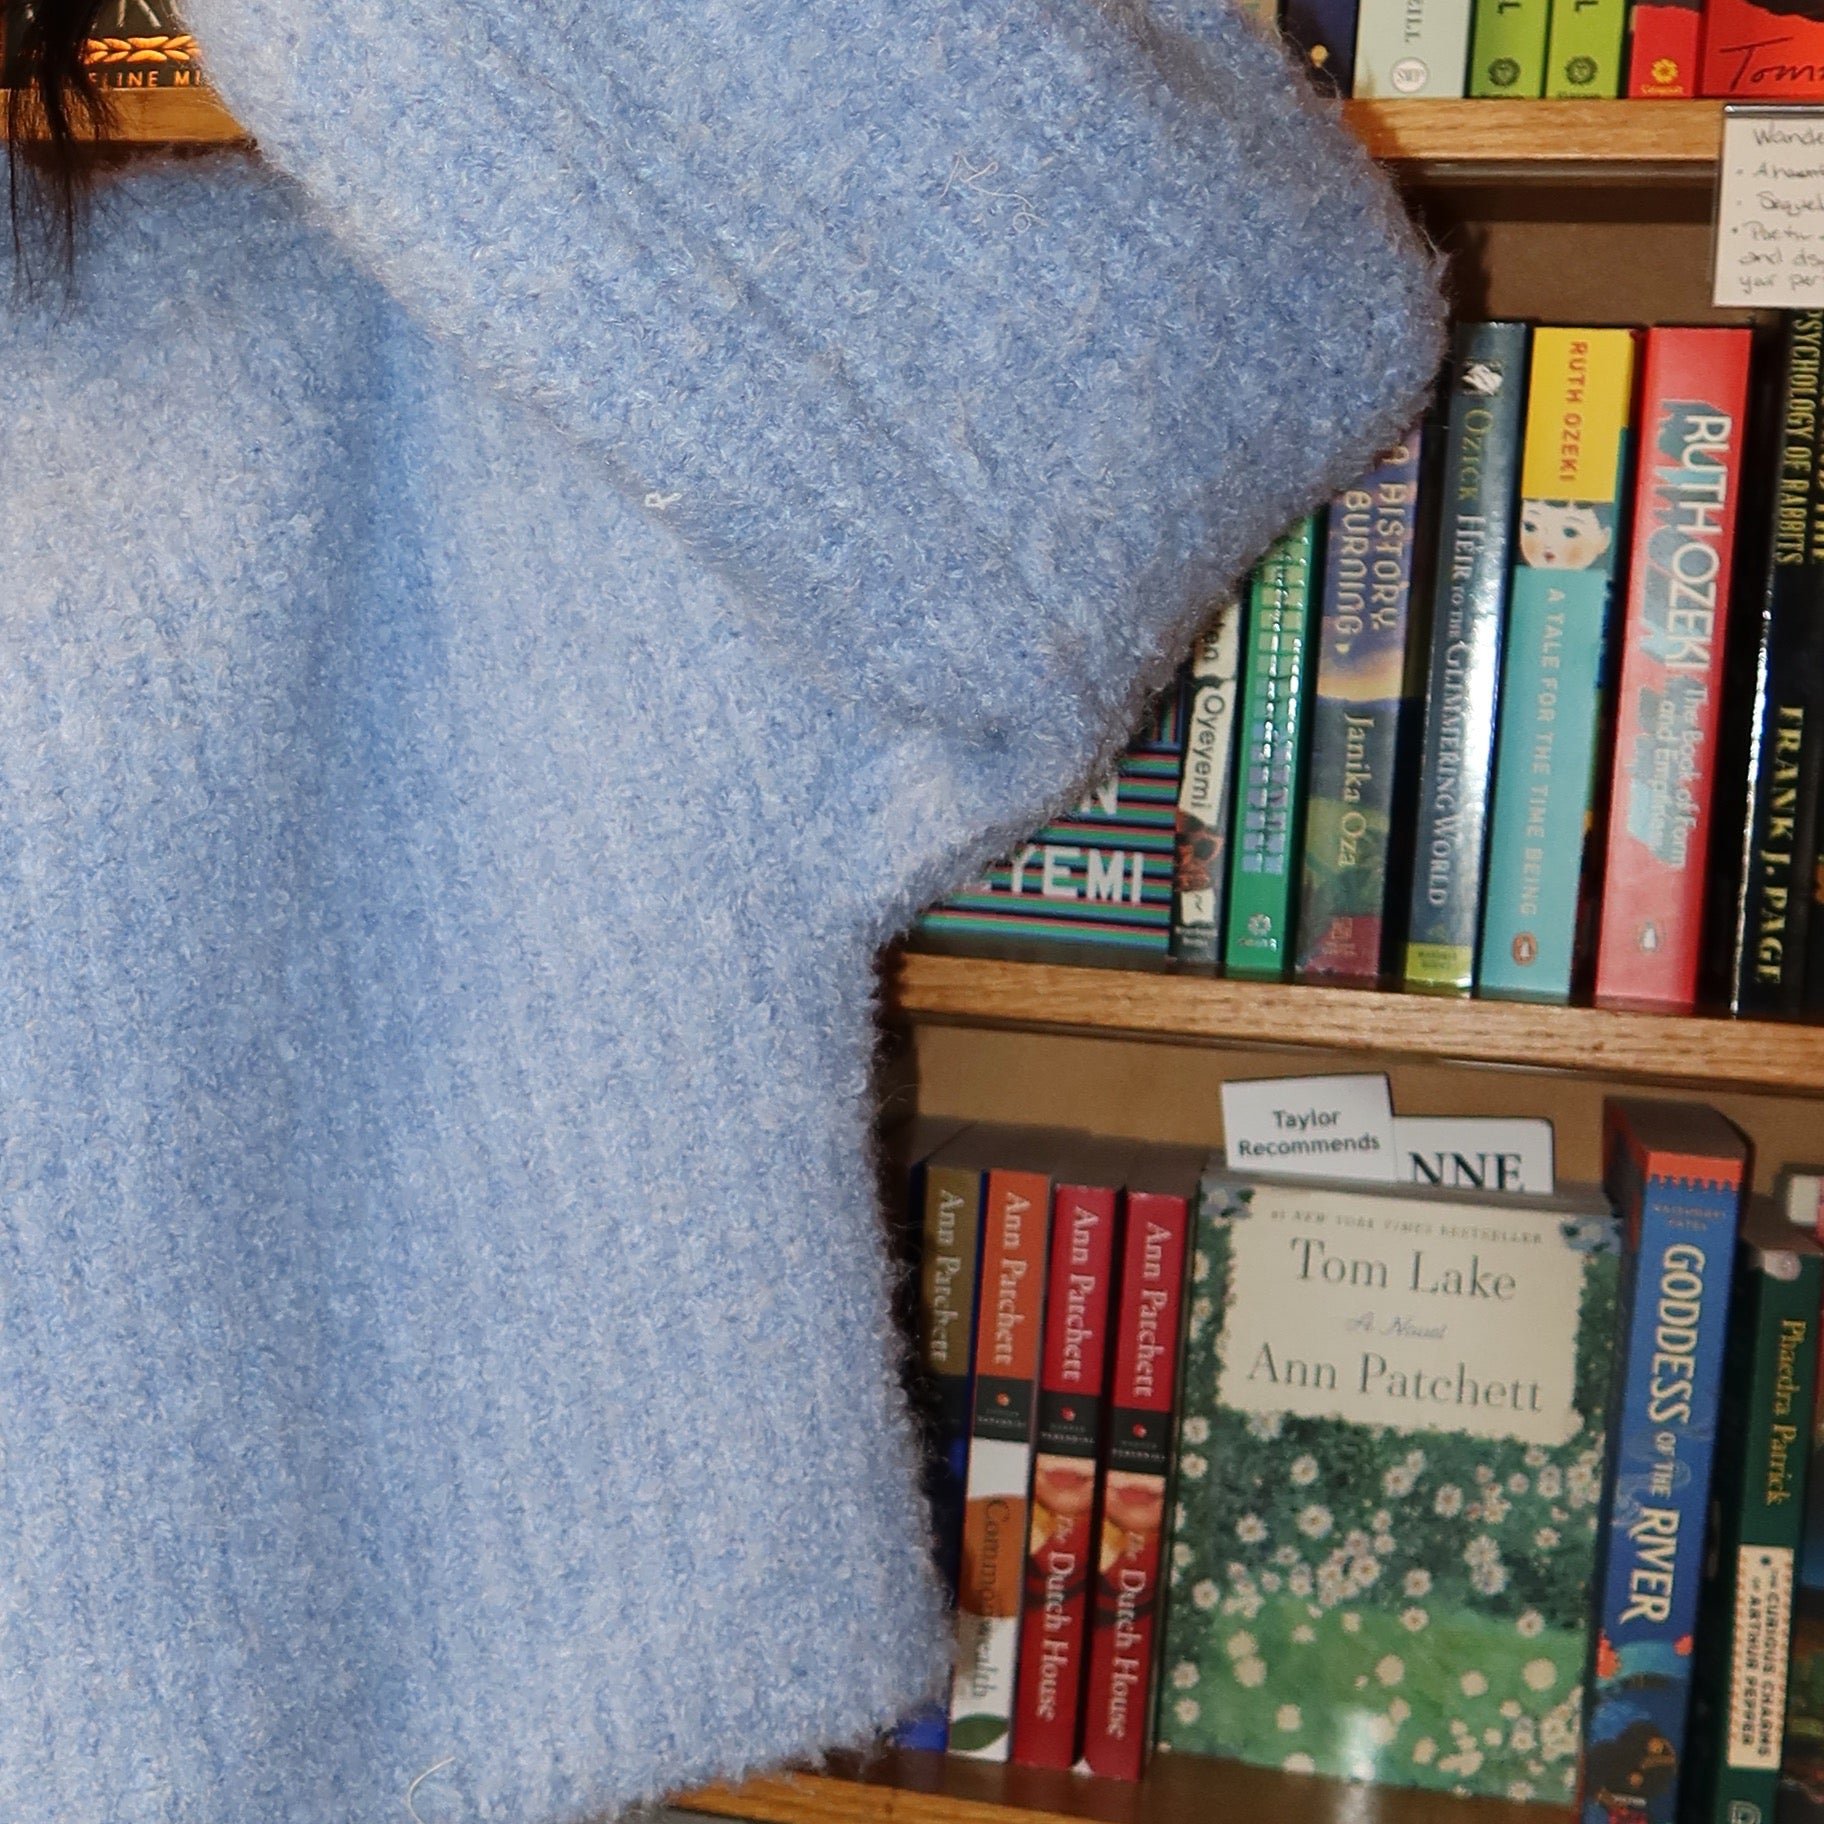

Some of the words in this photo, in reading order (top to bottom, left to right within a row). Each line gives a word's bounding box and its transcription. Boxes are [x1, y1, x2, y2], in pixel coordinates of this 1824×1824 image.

[1570, 340, 1590, 408] RUTH
[1560, 413, 1582, 482] OZEKI
[1676, 414, 1732, 535] RUTH
[1548, 588, 1565, 603] A
[1665, 542, 1720, 670] OZEKI
[1541, 613, 1565, 669] TALE
[1538, 677, 1558, 723] FOR
[1190, 693, 1225, 809] Oyeyemi
[1343, 713, 1374, 804] Janika
[1533, 732, 1553, 774] THE
[1337, 811, 1368, 868] Oza
[1528, 784, 1549, 838] TIME
[1521, 848, 1541, 916] BEING
[1237, 1134, 1381, 1158] Recommends
[1272, 1106, 1341, 1133] Taylor
[1003, 1191, 1032, 1251] Ann
[1070, 1204, 1101, 1265] Ann
[1289, 1236, 1391, 1290] Tom
[1409, 1249, 1517, 1303] Lake
[994, 1256, 1029, 1364] Patchett
[1061, 1272, 1095, 1382] Patchett
[1647, 1243, 1706, 1425] GODDESS
[1246, 1341, 1339, 1391] Ann
[1357, 1351, 1545, 1414] Patchett
[1773, 1318, 1807, 1415] Phaedra
[1654, 1431, 1676, 1455] OF
[1766, 1423, 1797, 1506] Patrick
[1650, 1460, 1674, 1498] THE
[1619, 1507, 1681, 1625] RIVER
